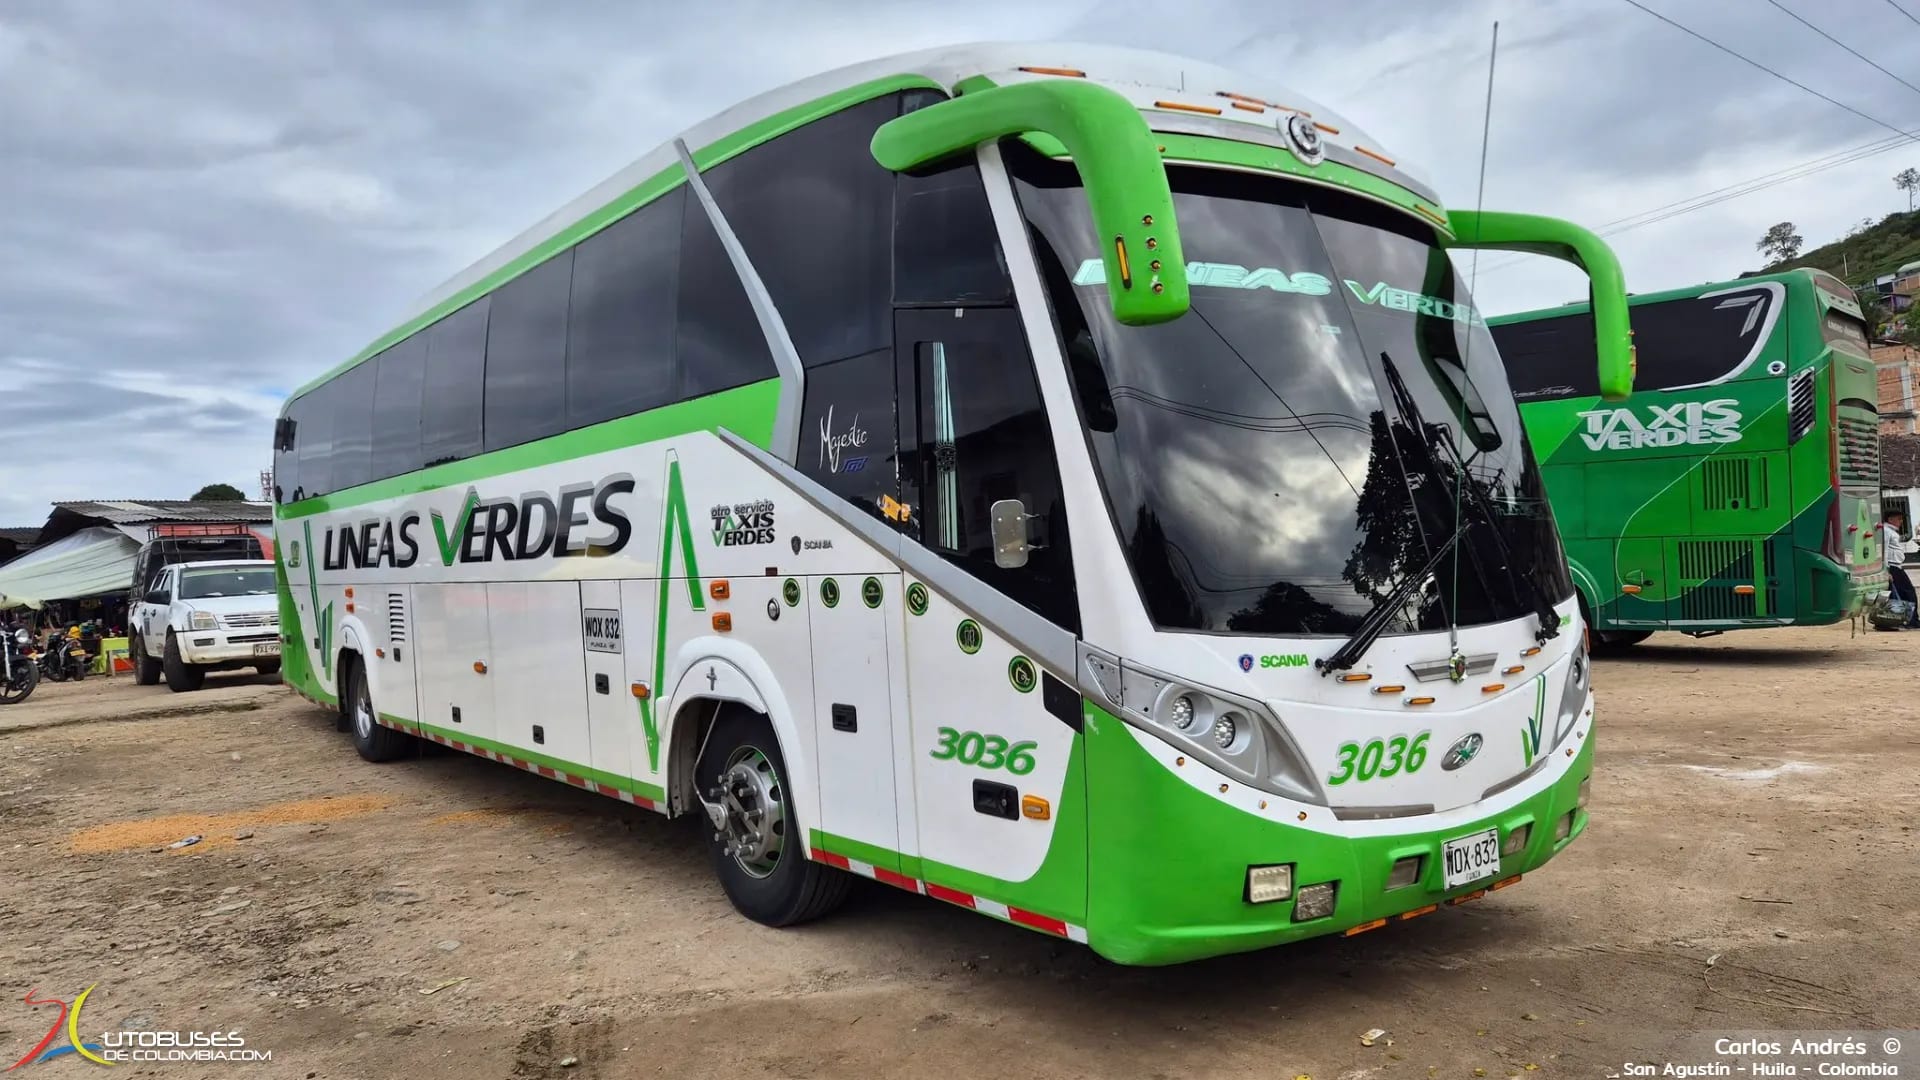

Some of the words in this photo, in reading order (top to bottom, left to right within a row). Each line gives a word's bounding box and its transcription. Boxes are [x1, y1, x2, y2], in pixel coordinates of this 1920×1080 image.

[1576, 398, 1743, 434] TAXIS
[819, 404, 868, 474] Majestic
[1578, 424, 1743, 451] VERDES
[323, 510, 421, 571] LINEAS
[429, 471, 636, 568] VERDES
[711, 504, 731, 517] otro
[734, 498, 775, 515] servicio
[711, 512, 775, 532] TAXIS
[711, 527, 776, 548] VERDES
[585, 616, 604, 638] WOX
[604, 617, 620, 640] 832
[1260, 654, 1309, 669] SCANIA
[929, 726, 1038, 776] 3036
[1327, 729, 1432, 787] 3036
